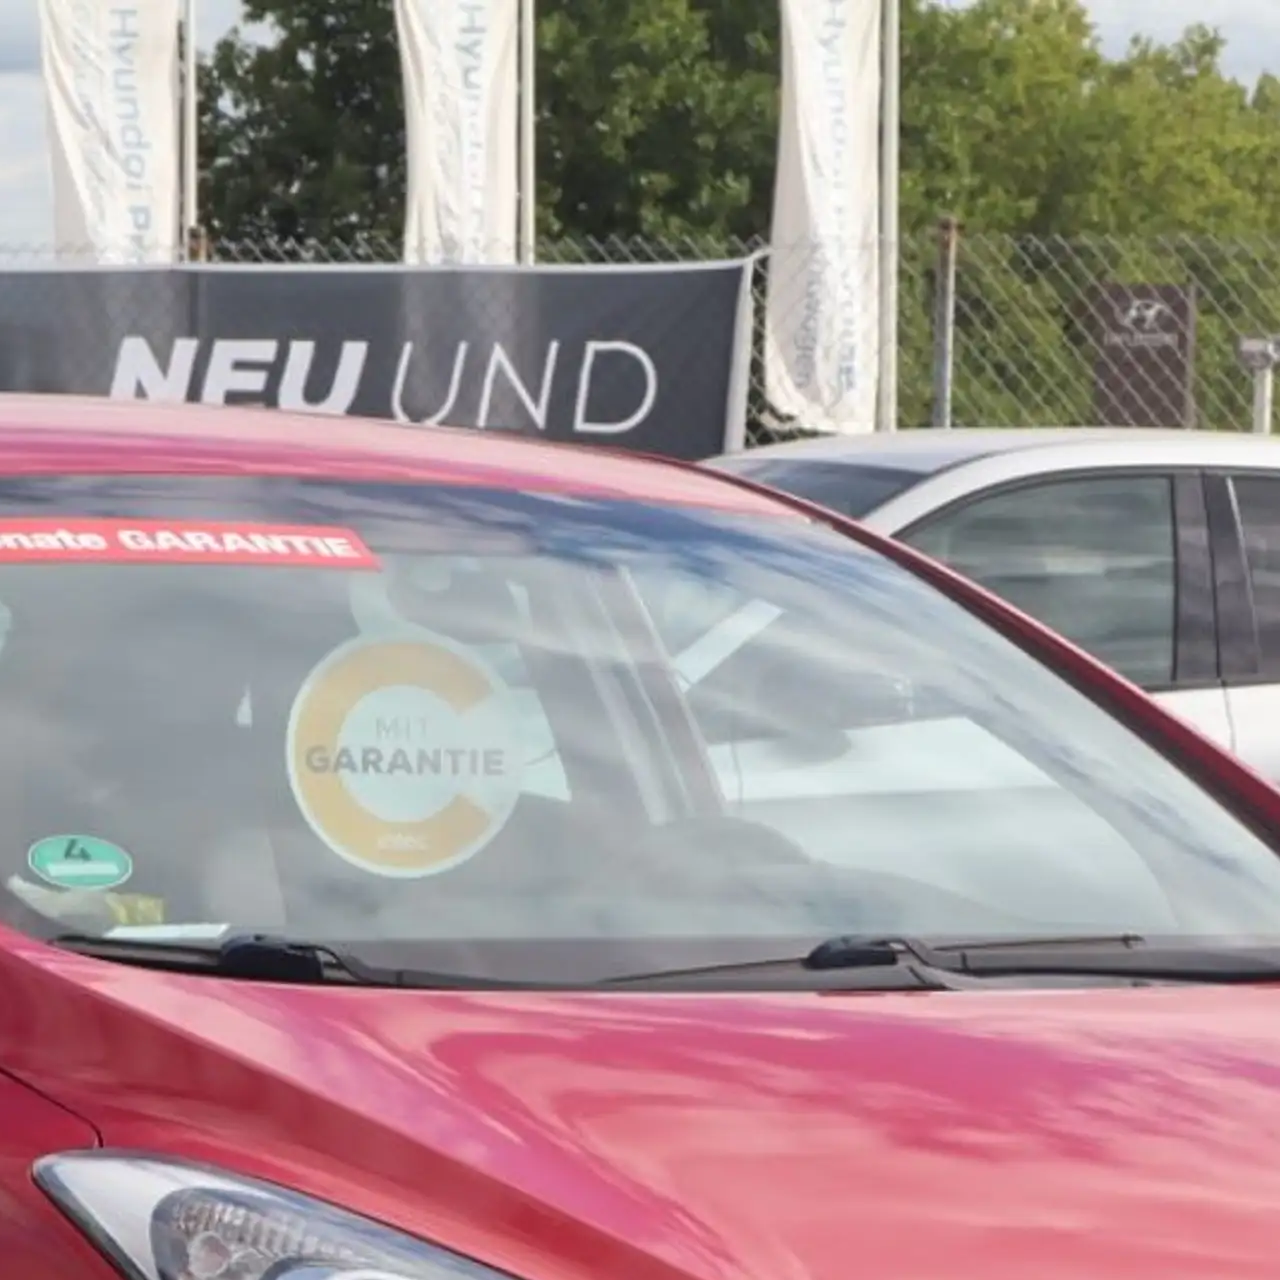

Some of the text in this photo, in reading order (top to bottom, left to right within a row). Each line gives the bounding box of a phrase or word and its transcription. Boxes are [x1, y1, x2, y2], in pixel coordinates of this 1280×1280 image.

[108, 8, 153, 190] Hyundai
[108, 336, 659, 433] NEU UND
[118, 528, 364, 560] GARANTIE
[374, 715, 429, 741] MIT
[304, 745, 505, 777] GARANTIE
[64, 838, 92, 862] 4
